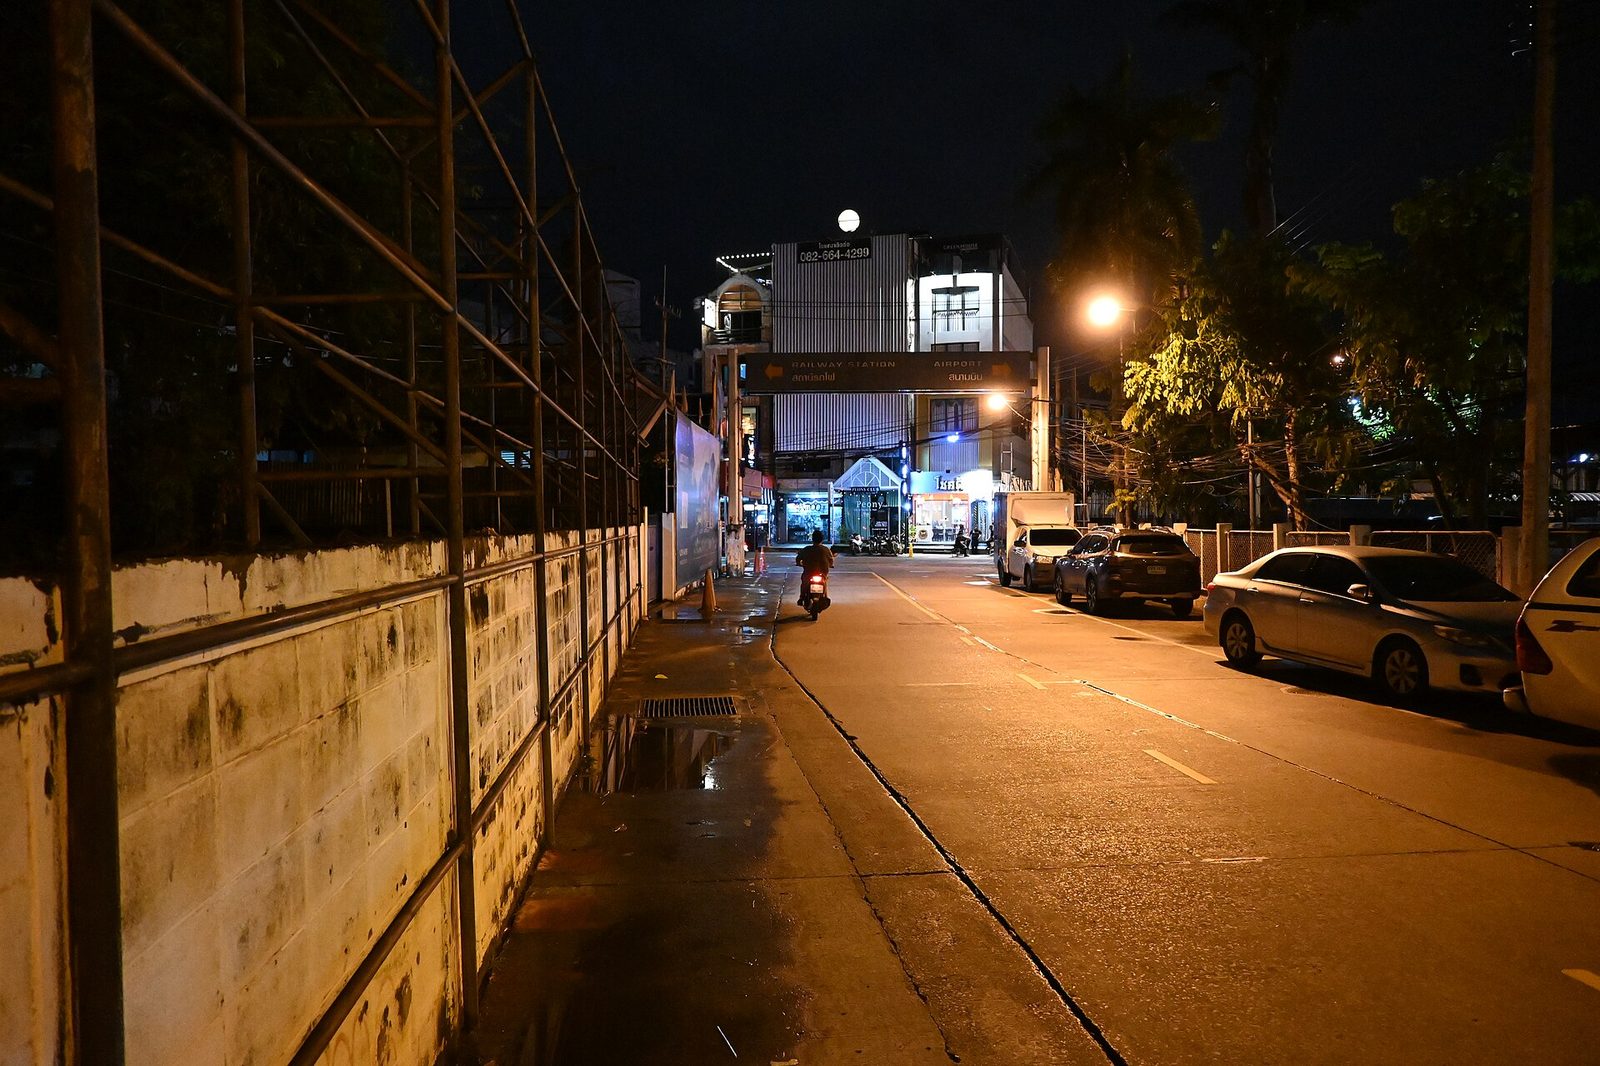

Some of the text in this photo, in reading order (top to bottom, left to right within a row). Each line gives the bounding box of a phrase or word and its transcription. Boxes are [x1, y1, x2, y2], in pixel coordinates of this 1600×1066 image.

[800, 247, 869, 262] 082-664-4299
[847, 360, 896, 368] STATION
[933, 360, 983, 368] AIRPORT
[791, 371, 836, 382] สถานีรถไฟ
[948, 371, 983, 381] สนามบิน
[856, 500, 883, 509] Peony
